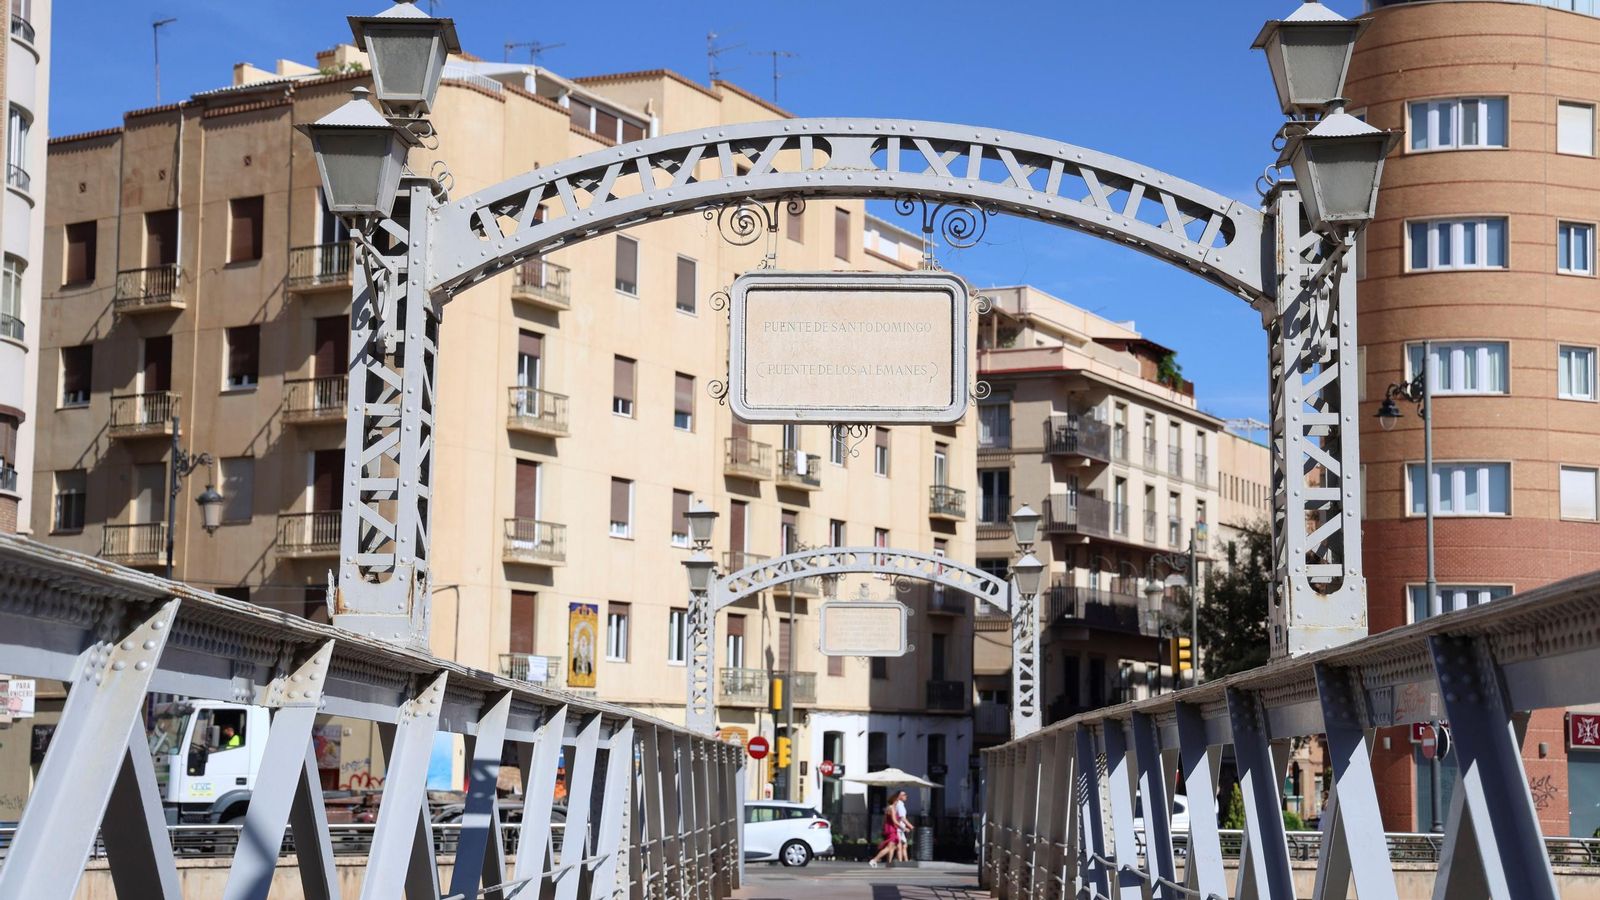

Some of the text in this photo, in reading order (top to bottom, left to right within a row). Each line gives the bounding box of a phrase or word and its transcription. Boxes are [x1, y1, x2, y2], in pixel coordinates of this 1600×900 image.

[764, 321, 932, 333] PUENTE DE SANTO DOMINGO
[818, 364, 833, 375] DE
[835, 364, 857, 376] LOS
